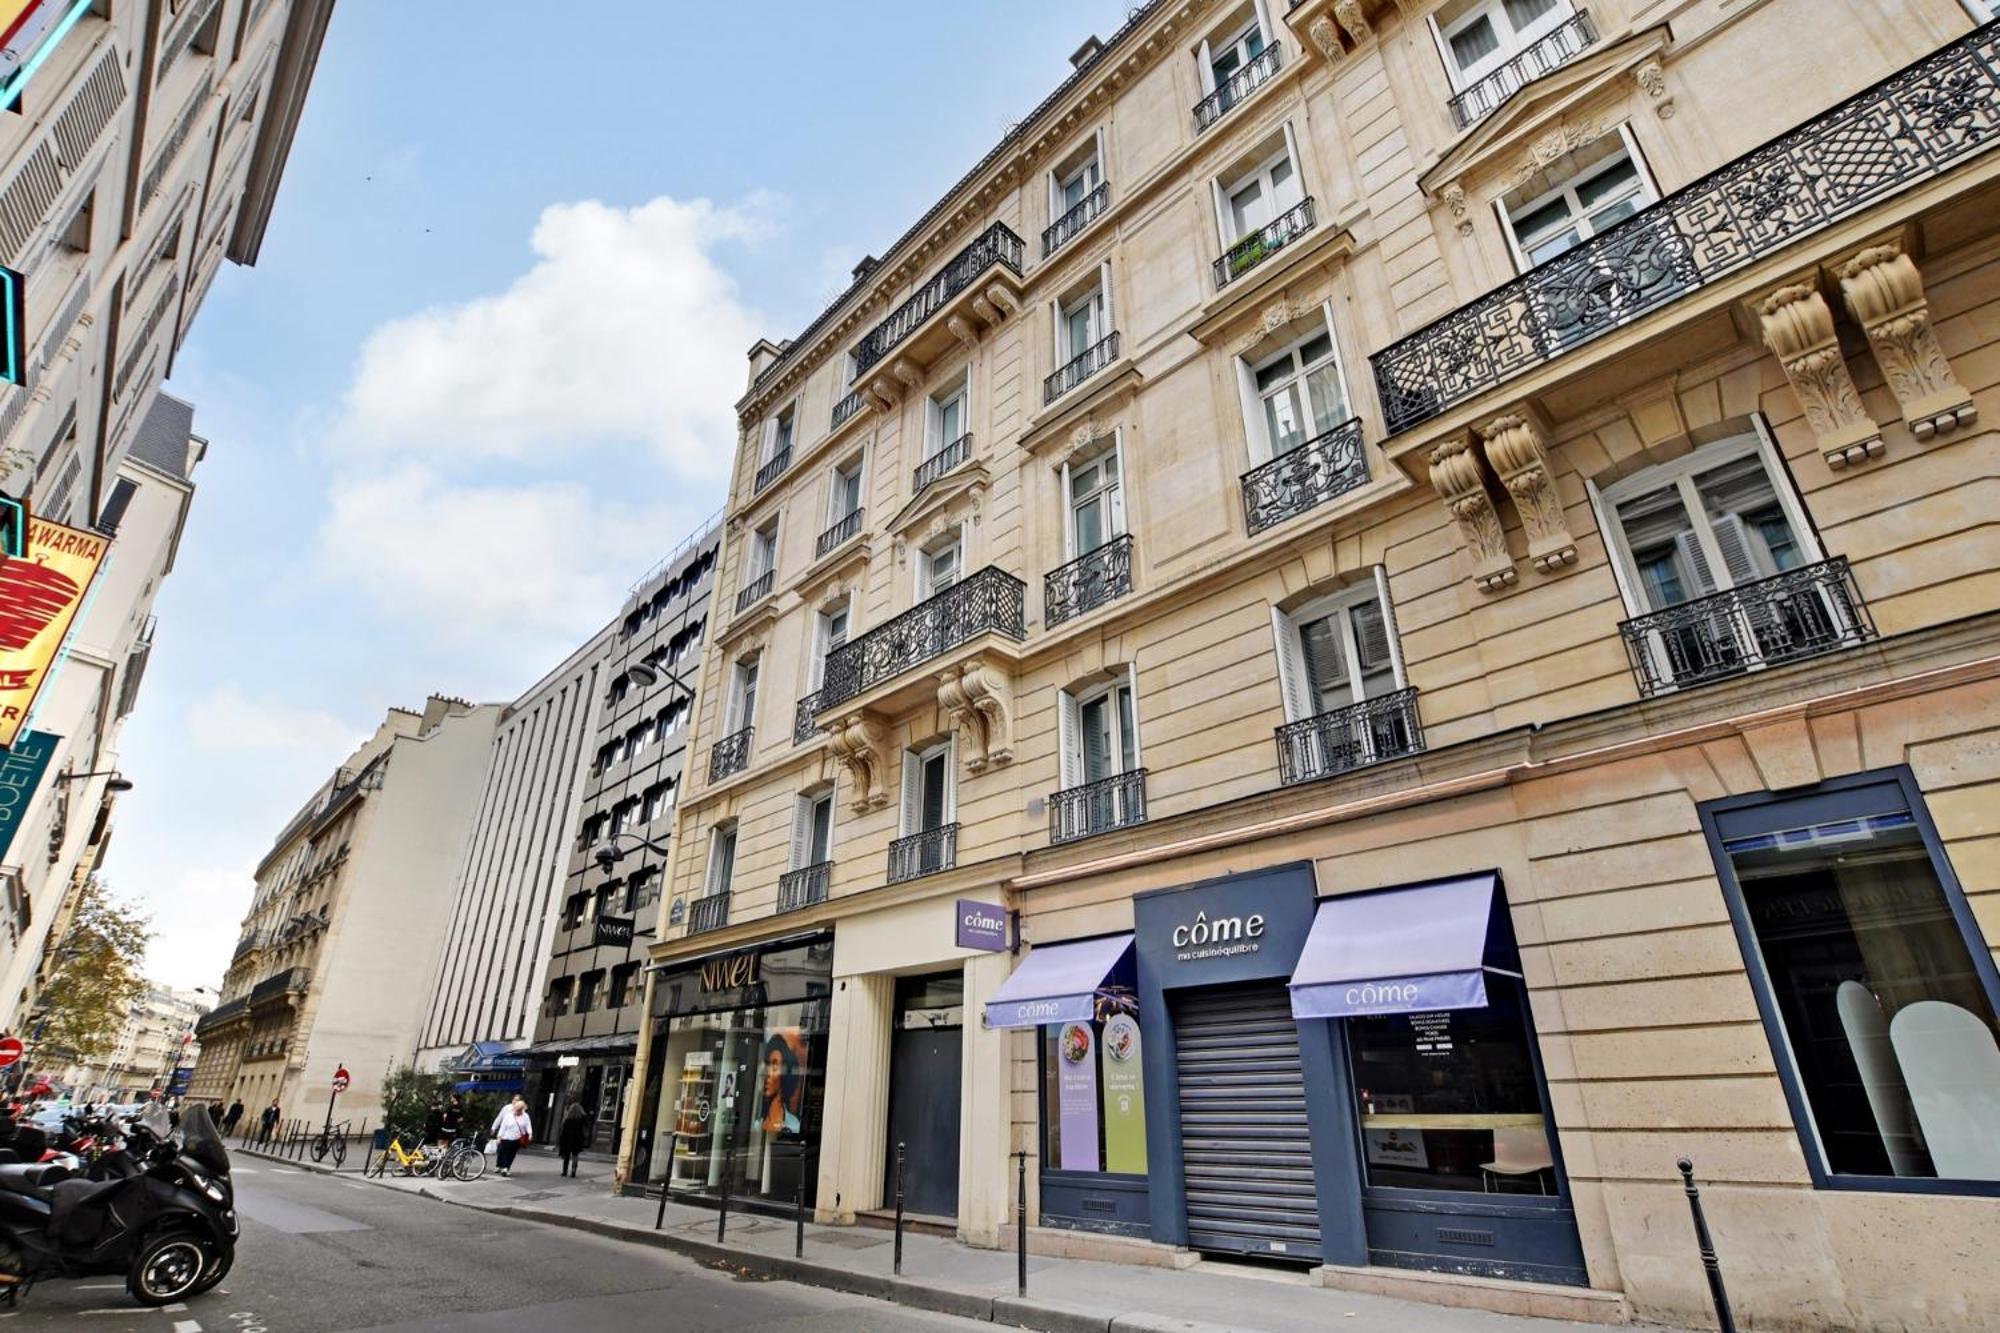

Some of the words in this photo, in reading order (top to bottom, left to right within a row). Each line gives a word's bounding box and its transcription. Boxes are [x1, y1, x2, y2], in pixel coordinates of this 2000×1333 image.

[964, 911, 1004, 930] côme
[1173, 910, 1264, 947] côme
[1345, 983, 1418, 1005] côme
